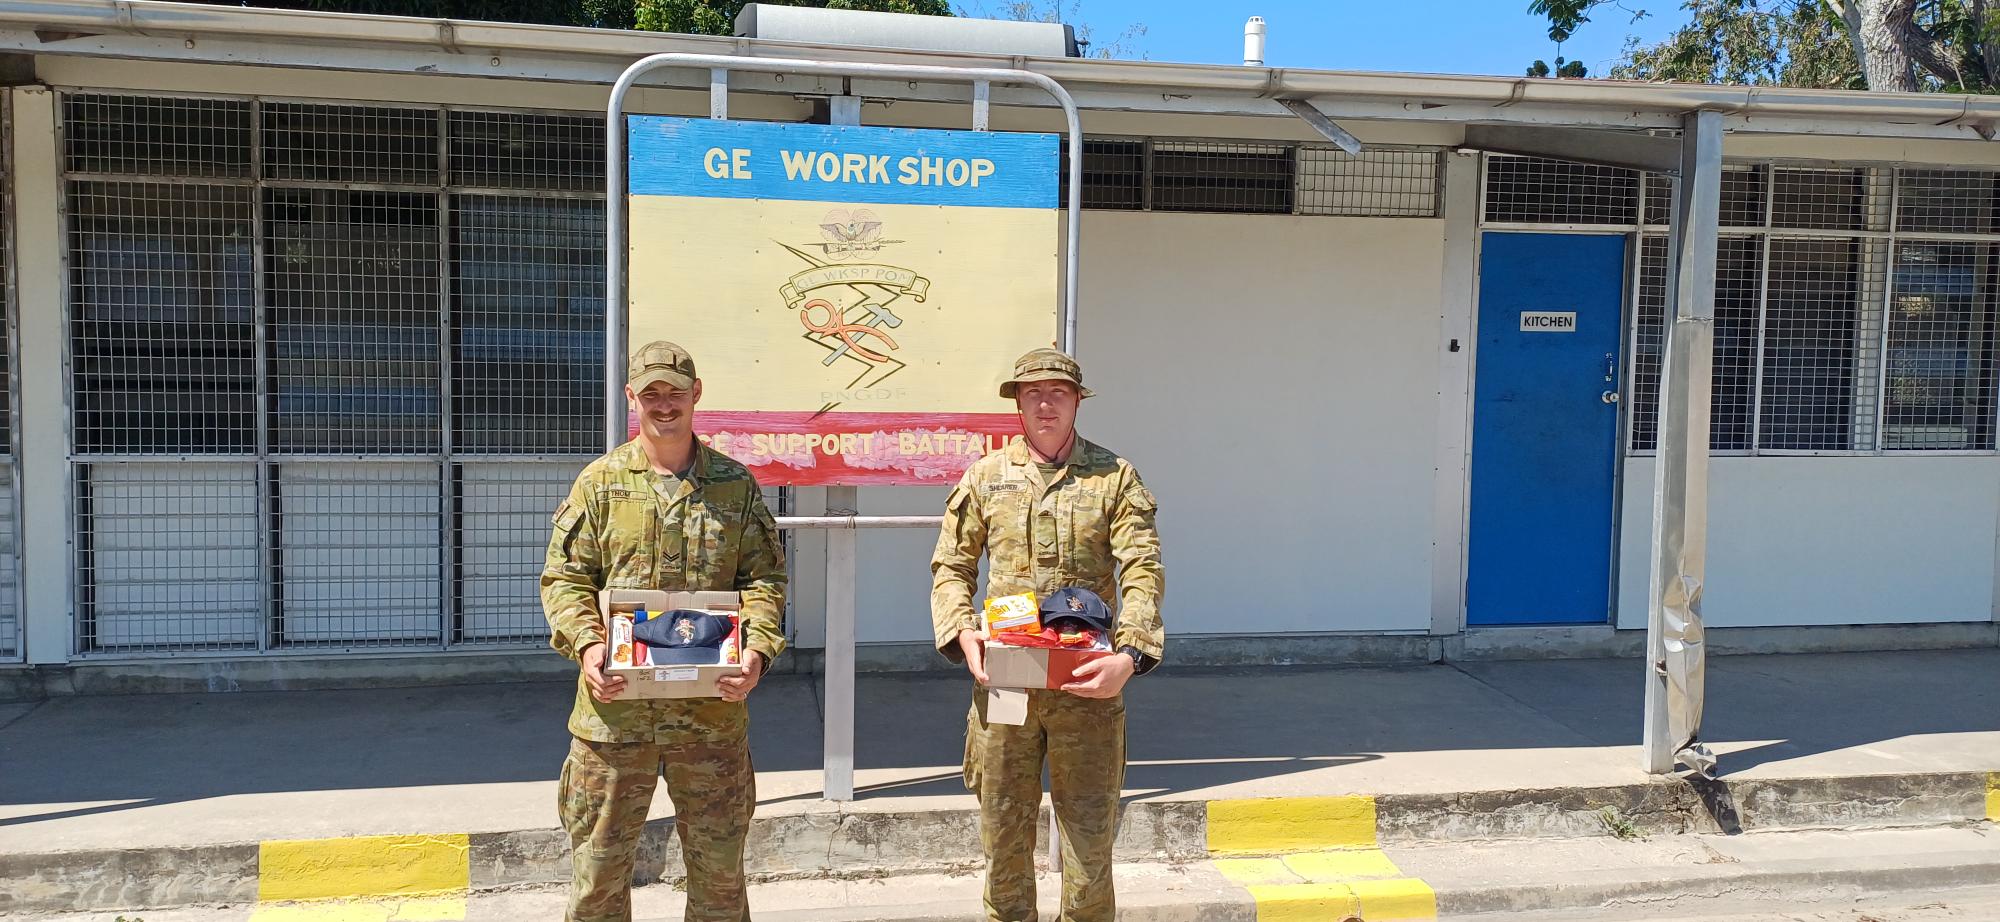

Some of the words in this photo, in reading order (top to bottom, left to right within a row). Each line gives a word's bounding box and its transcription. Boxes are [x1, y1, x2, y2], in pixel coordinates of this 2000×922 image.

[704, 147, 752, 180] GE
[823, 268, 870, 281] WKSP
[875, 269, 913, 283] POM
[1523, 315, 1573, 327] KITCHEN
[751, 433, 872, 456] SUPPORT
